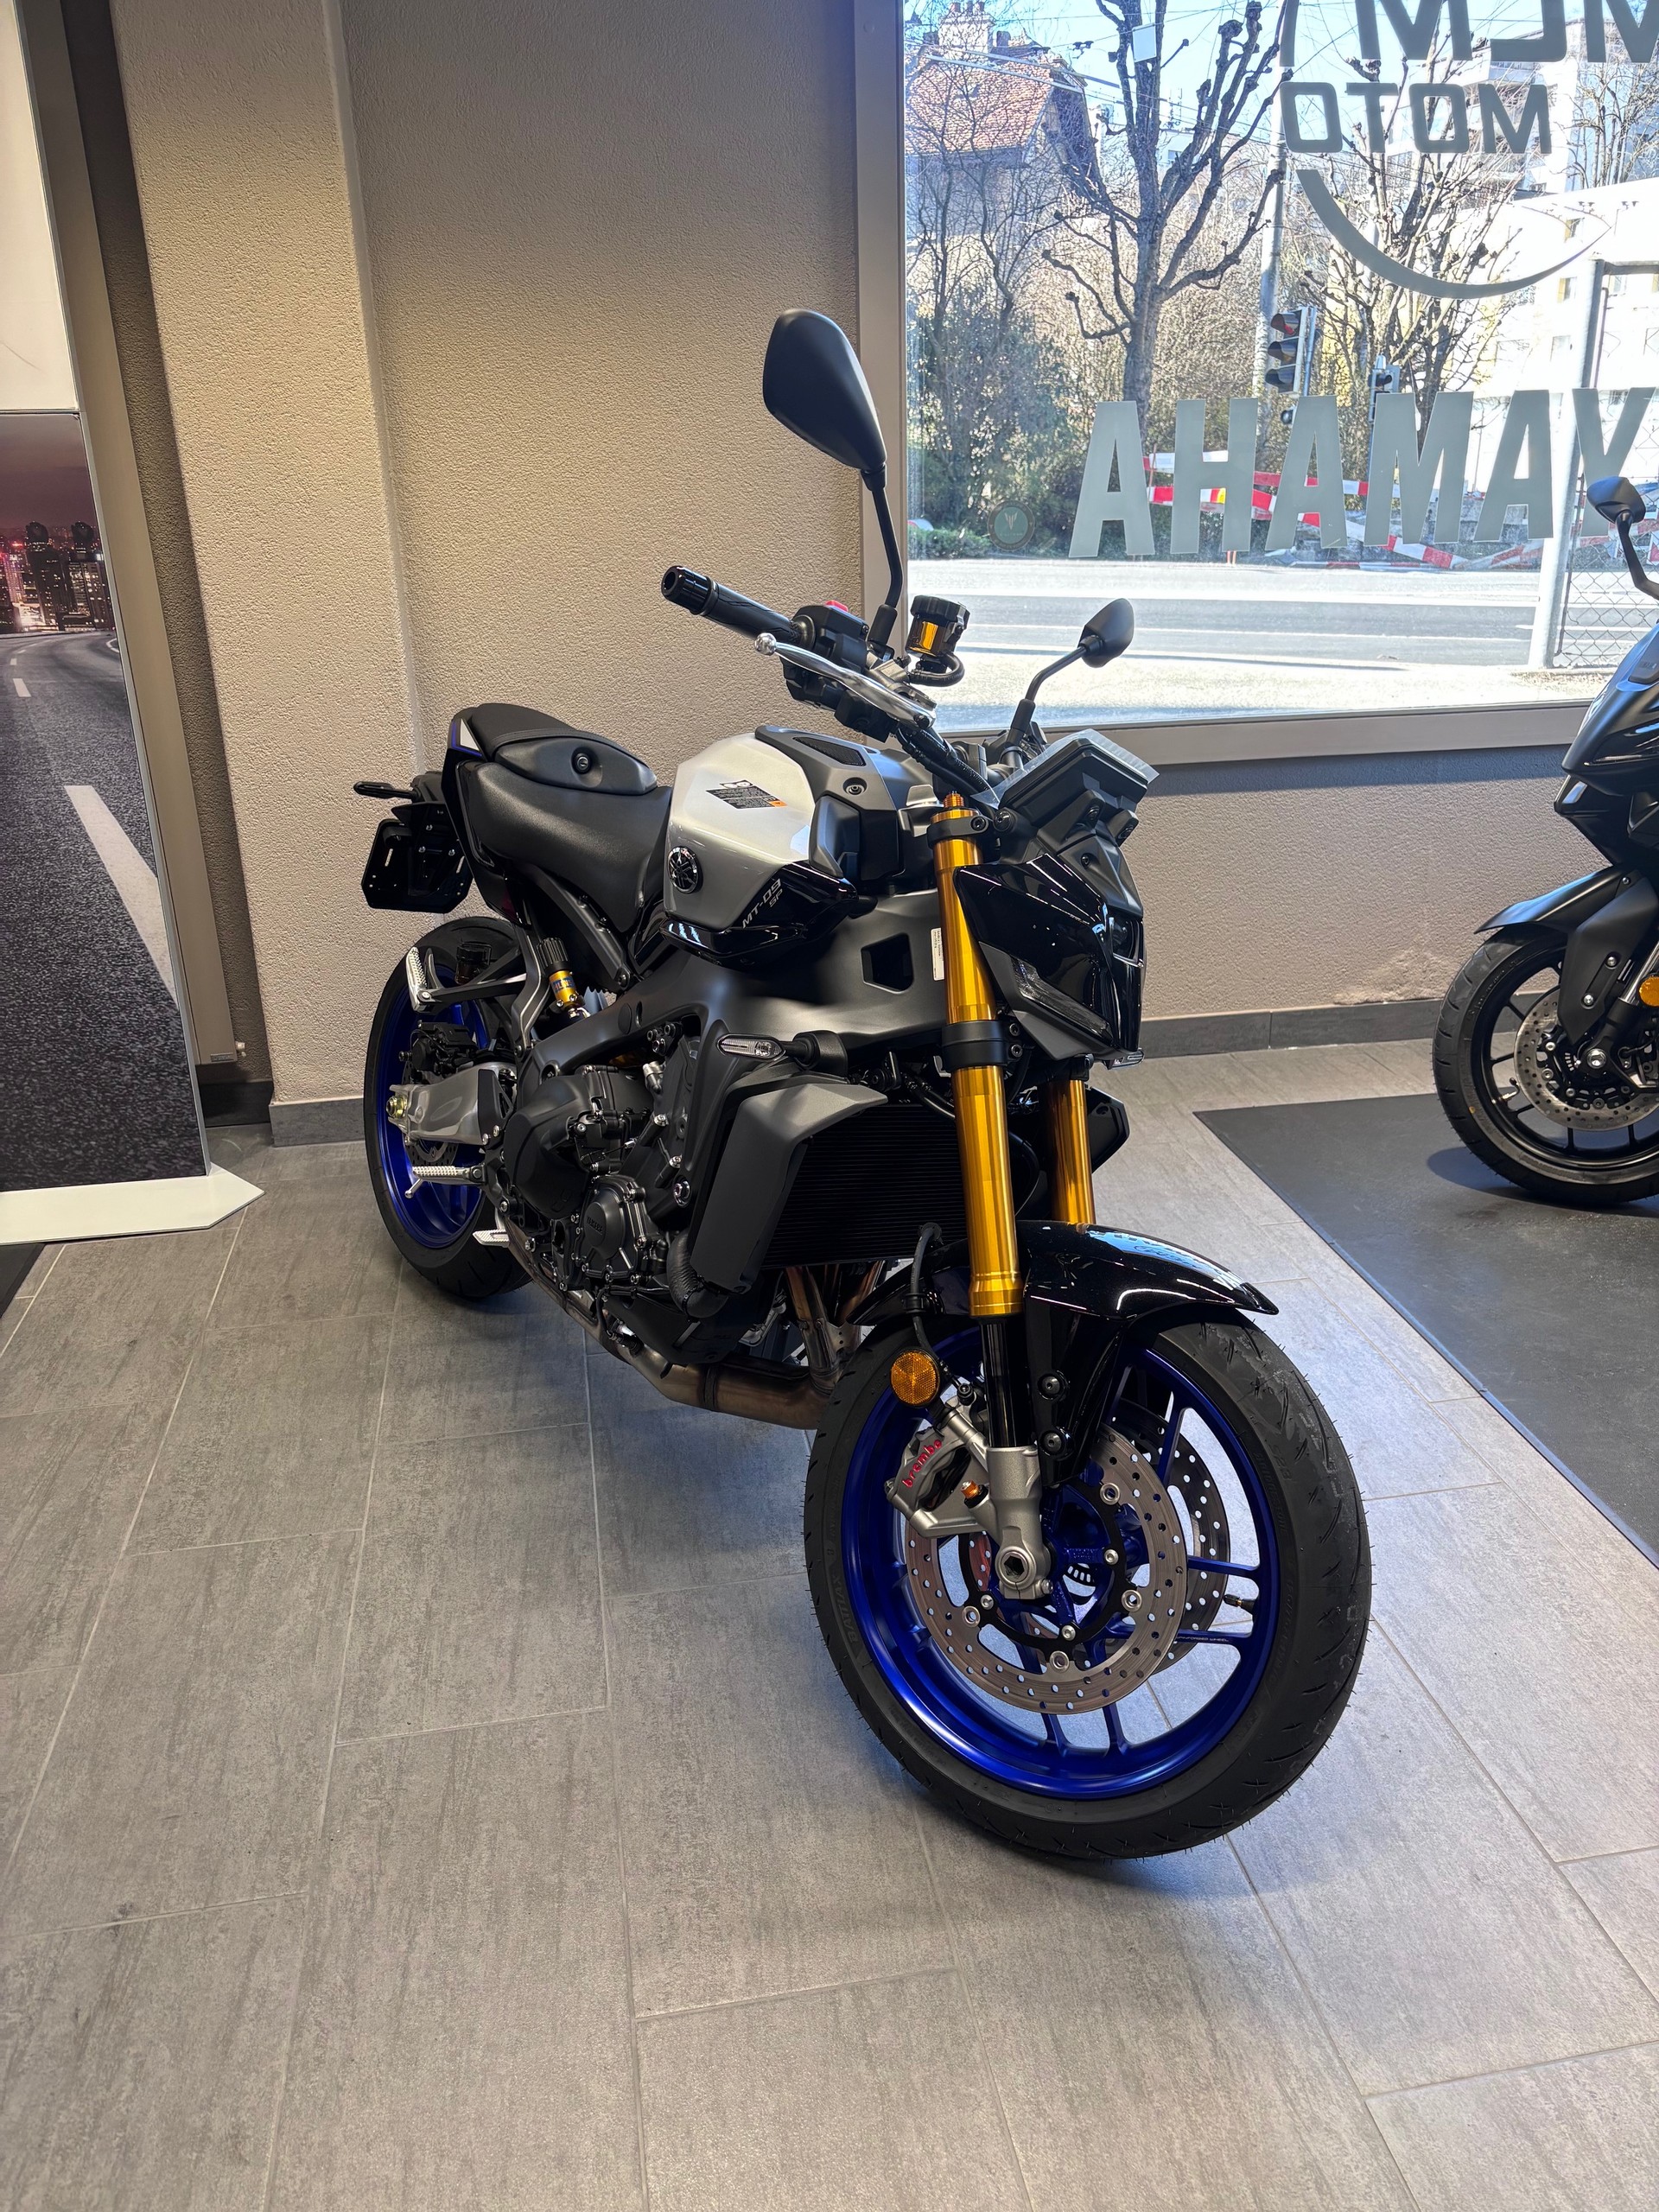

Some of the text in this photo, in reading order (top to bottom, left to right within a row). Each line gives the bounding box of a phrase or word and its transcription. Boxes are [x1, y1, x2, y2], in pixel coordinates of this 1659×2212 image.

[742, 878, 782, 929] MT-09
[769, 888, 783, 907] SP
[901, 1439, 943, 1488] brembo
